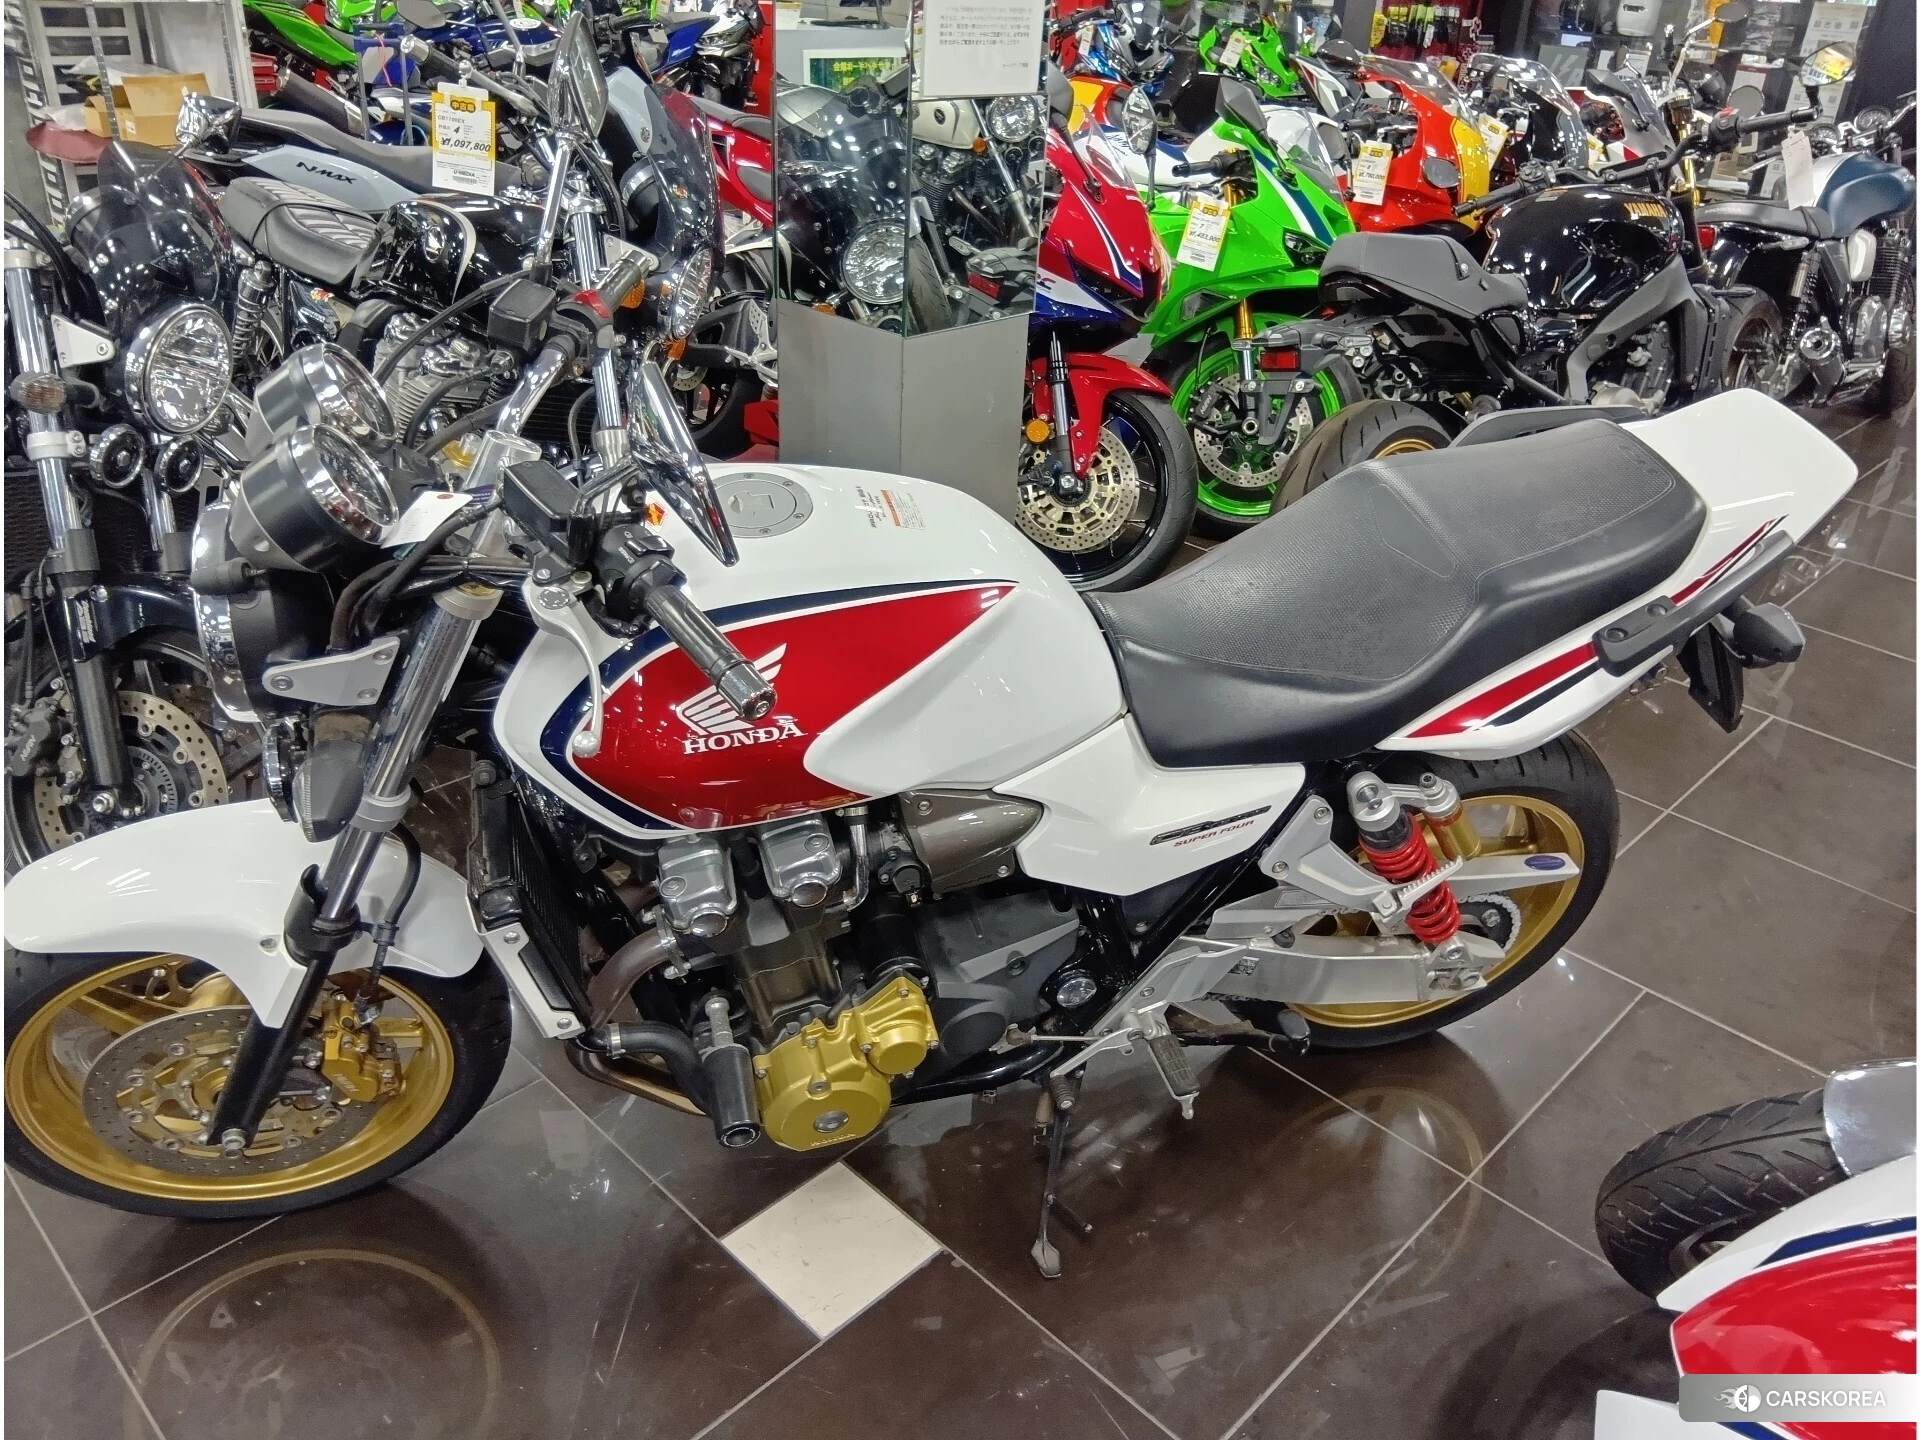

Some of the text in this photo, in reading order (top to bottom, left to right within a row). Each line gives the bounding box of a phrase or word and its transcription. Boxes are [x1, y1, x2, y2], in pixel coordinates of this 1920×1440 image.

[1623, 202, 1667, 218] YAMAHA
[1704, 207, 1742, 215] HONDA
[683, 722, 806, 755] HONDA
[1173, 819, 1255, 847] SUPER FOUR
